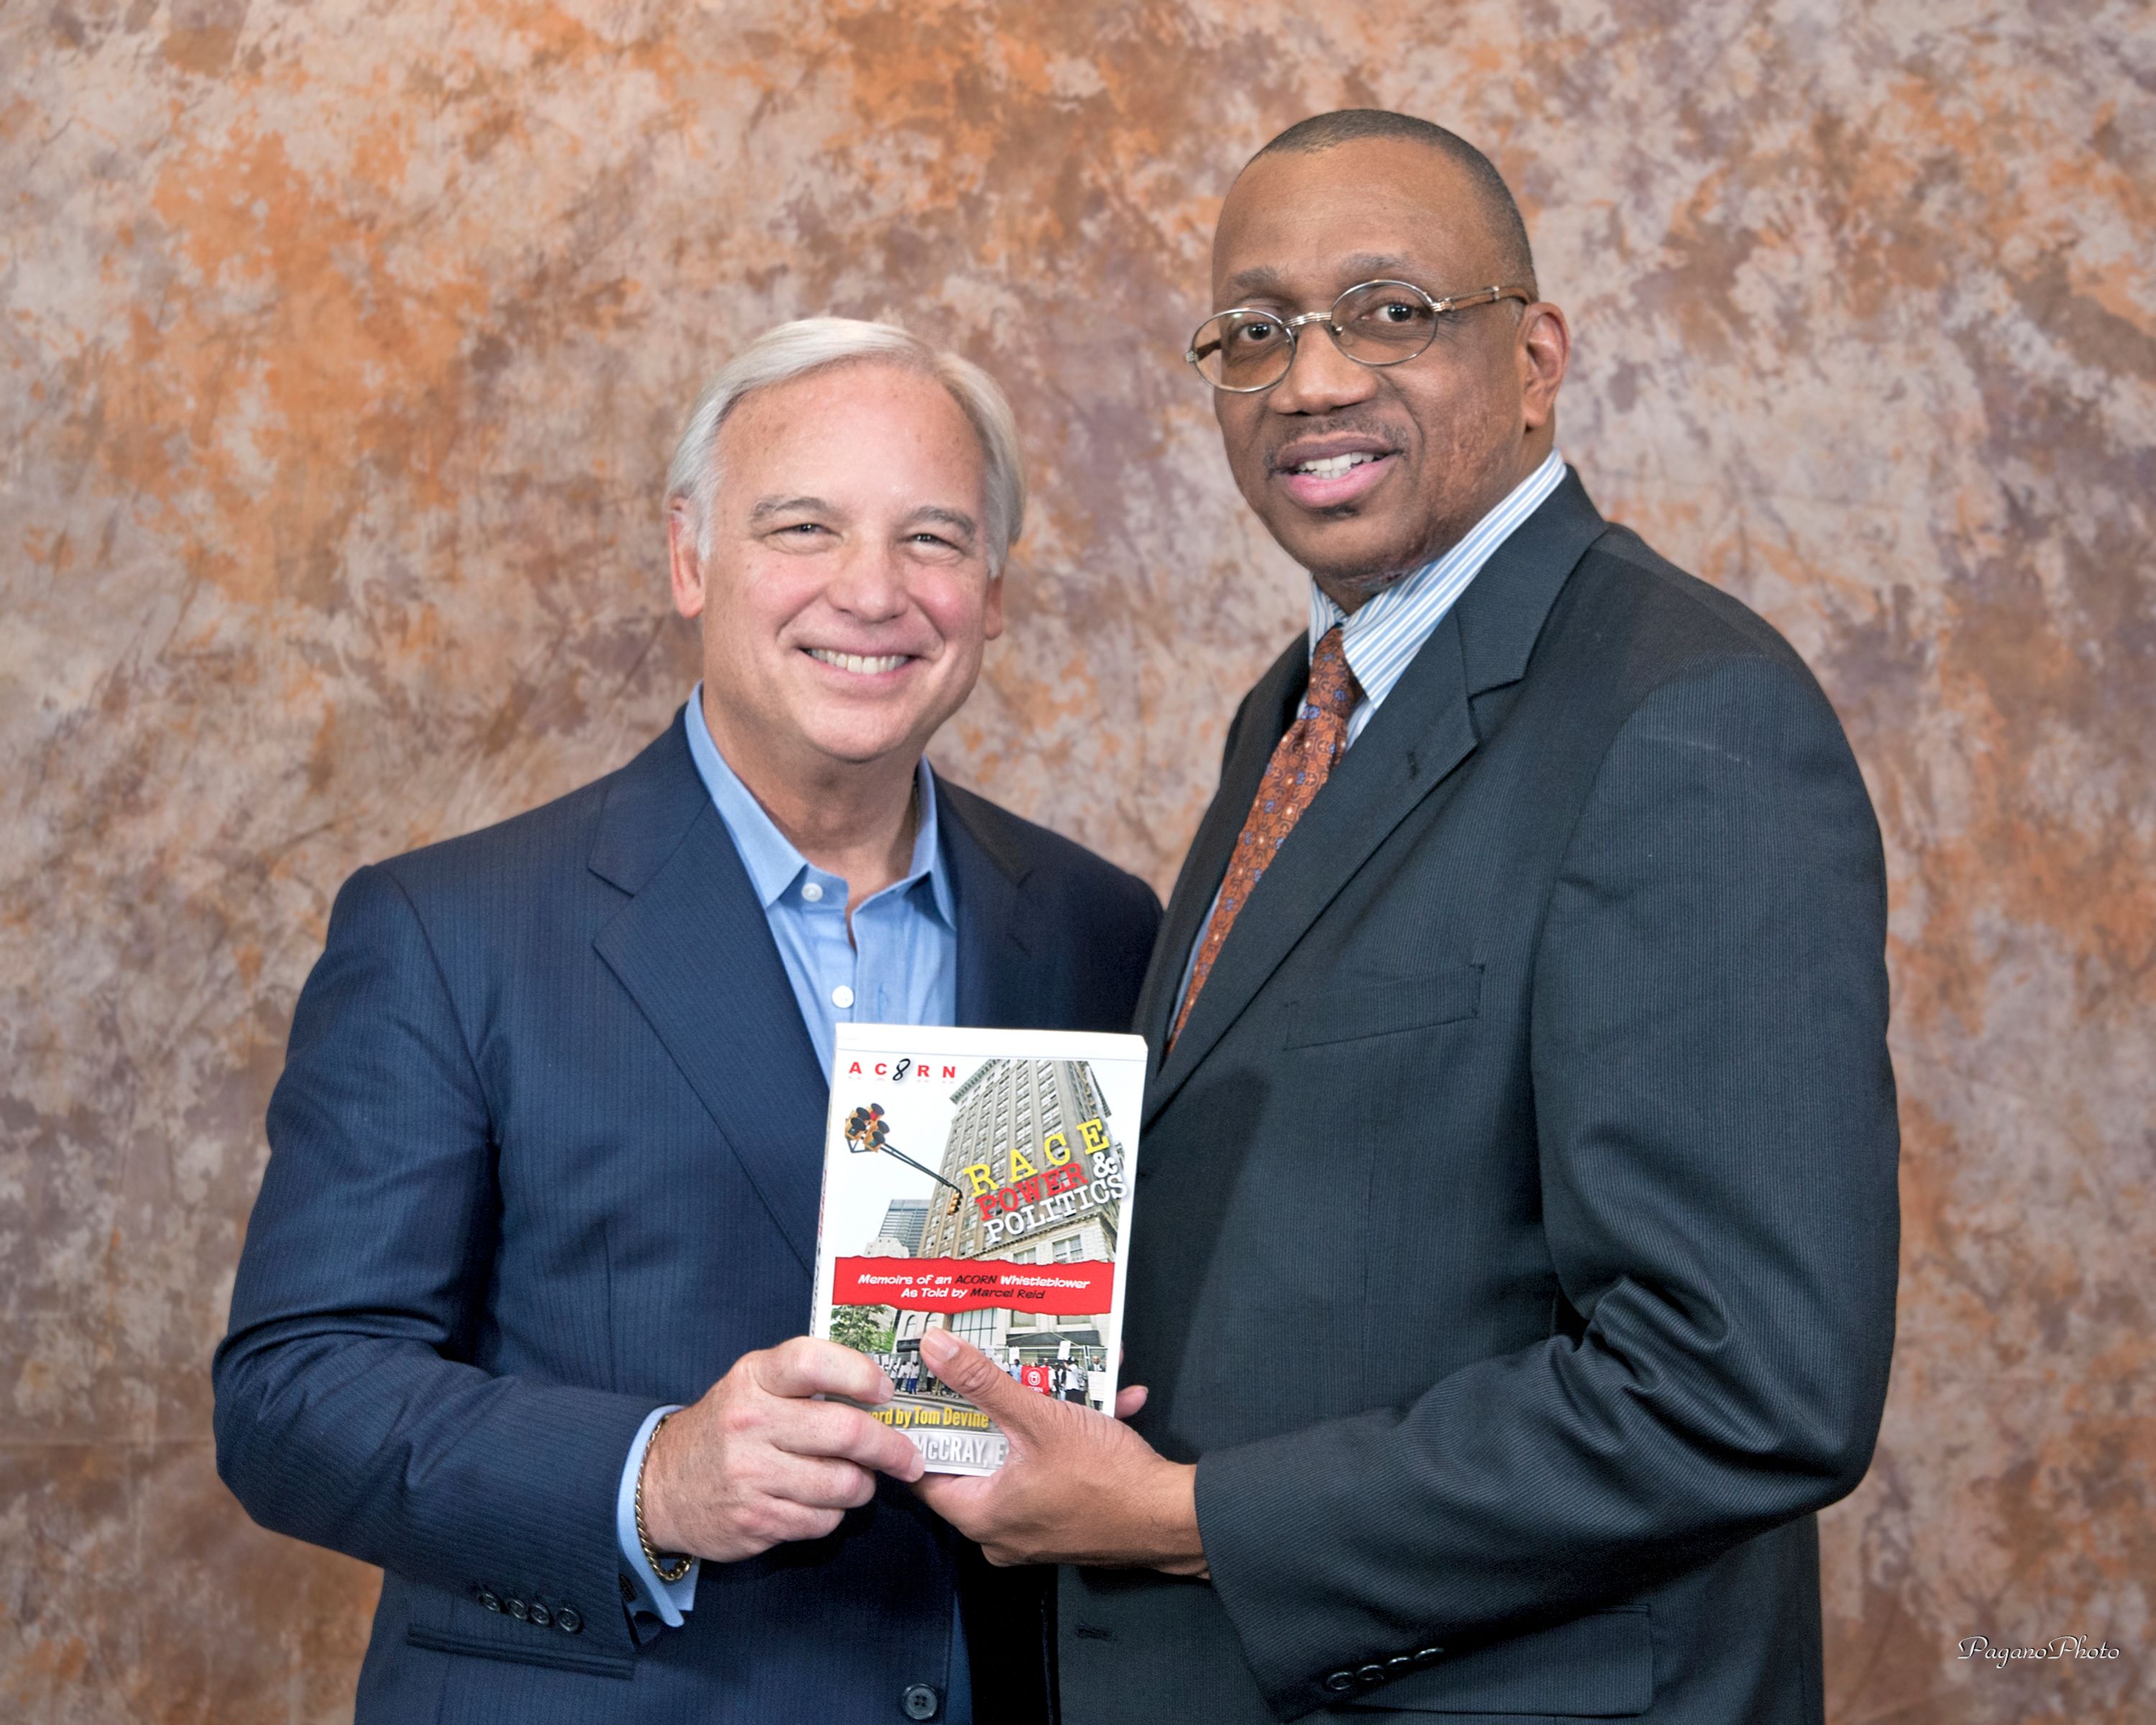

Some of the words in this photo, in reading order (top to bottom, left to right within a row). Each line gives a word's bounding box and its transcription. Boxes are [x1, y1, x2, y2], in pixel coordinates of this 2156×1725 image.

[963, 1118, 1110, 1197] RACE
[975, 1162, 1088, 1220] POWER
[1093, 1152, 1118, 1178] &
[983, 1174, 1127, 1243] POLITICS
[857, 1274, 913, 1284] Memoirs
[916, 1274, 934, 1284] of
[935, 1276, 952, 1284] an
[955, 1275, 998, 1284] ACORN
[1000, 1275, 1090, 1289] Whistleblower
[900, 1288, 918, 1298] As
[921, 1288, 949, 1297] Told
[951, 1288, 967, 1299] by
[970, 1288, 1014, 1297] Marcel
[1017, 1289, 1045, 1299] Reid
[895, 1407, 912, 1429] by
[914, 1407, 941, 1425] Tom
[943, 1407, 990, 1429] Devine
